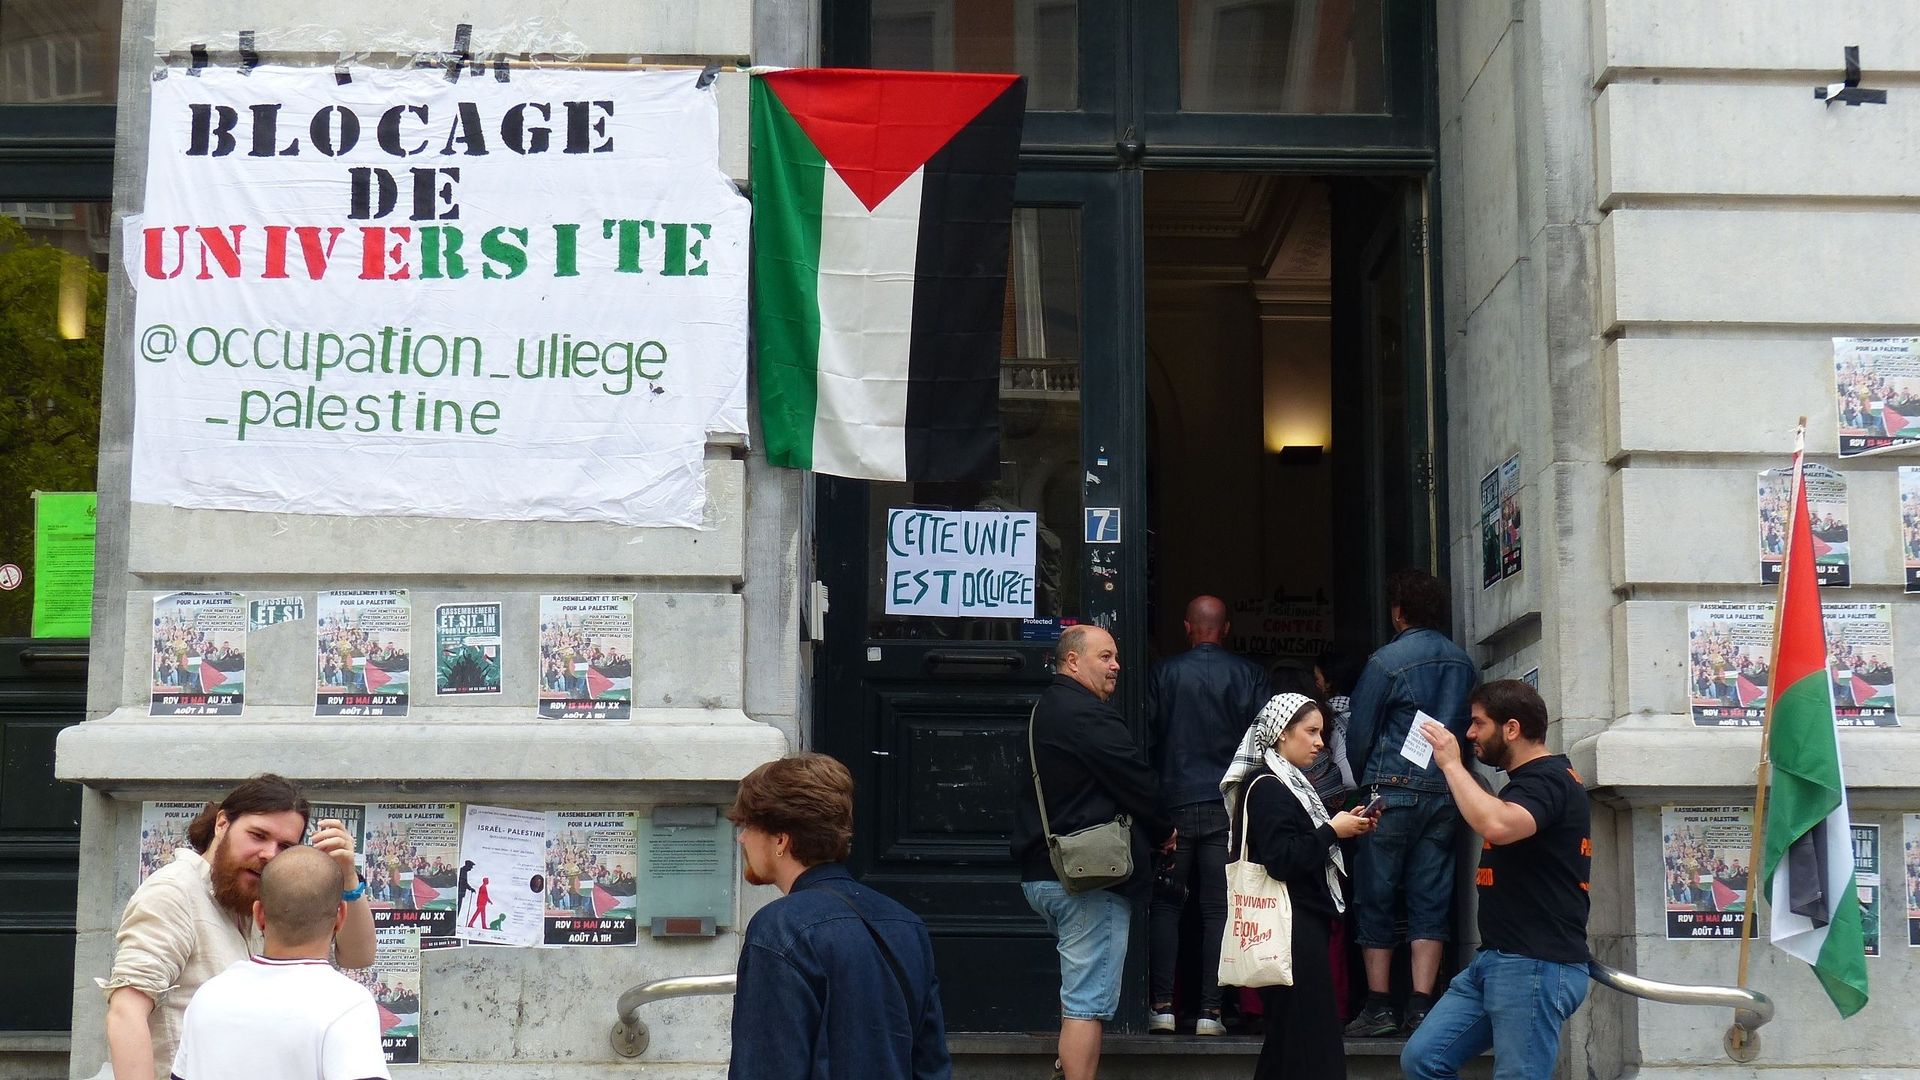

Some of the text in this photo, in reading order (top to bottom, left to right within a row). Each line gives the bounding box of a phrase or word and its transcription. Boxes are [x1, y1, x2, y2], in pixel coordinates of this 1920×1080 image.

[185, 100, 615, 157] BLOCAGE
[347, 167, 462, 221] DE
[143, 220, 712, 280] UNIVERSITE
[205, 387, 501, 440] _palestine
[1849, 438, 1866, 447] RDV
[1093, 510, 1110, 541] 7
[888, 510, 958, 557] CETTE
[1772, 565, 1782, 573] RD
[893, 567, 1034, 607] EST OCCUPÉE
[257, 606, 276, 624] ET
[441, 606, 496, 615] RASSEMBLEMENT
[441, 614, 496, 628] ET SIT-IN
[1247, 636, 1334, 653] COLONISATIO
[163, 696, 179, 704] RDV
[190, 696, 205, 704] MAI
[207, 696, 219, 704] AU
[327, 696, 344, 704] RDV
[355, 696, 370, 704] MAI
[372, 696, 384, 704] AU
[385, 696, 397, 704] XX
[174, 706, 196, 714] AOÛT
[197, 706, 205, 714] À
[339, 706, 362, 715] AOÛT
[362, 706, 370, 715] À
[1746, 709, 1757, 717] AU
[507, 828, 545, 838] PALESTINE
[1243, 895, 1277, 909] VIVANTS
[375, 912, 445, 920] RDV 13 MAI AU XX
[1678, 914, 1693, 922] RDV
[1695, 914, 1703, 922] 13
[1705, 914, 1720, 922] MAI
[1721, 914, 1733, 922] AU
[1692, 925, 1734, 935] AOÛT À 11H
[569, 932, 611, 942] AOÛT À 11H
[382, 1039, 407, 1047] AU XX
